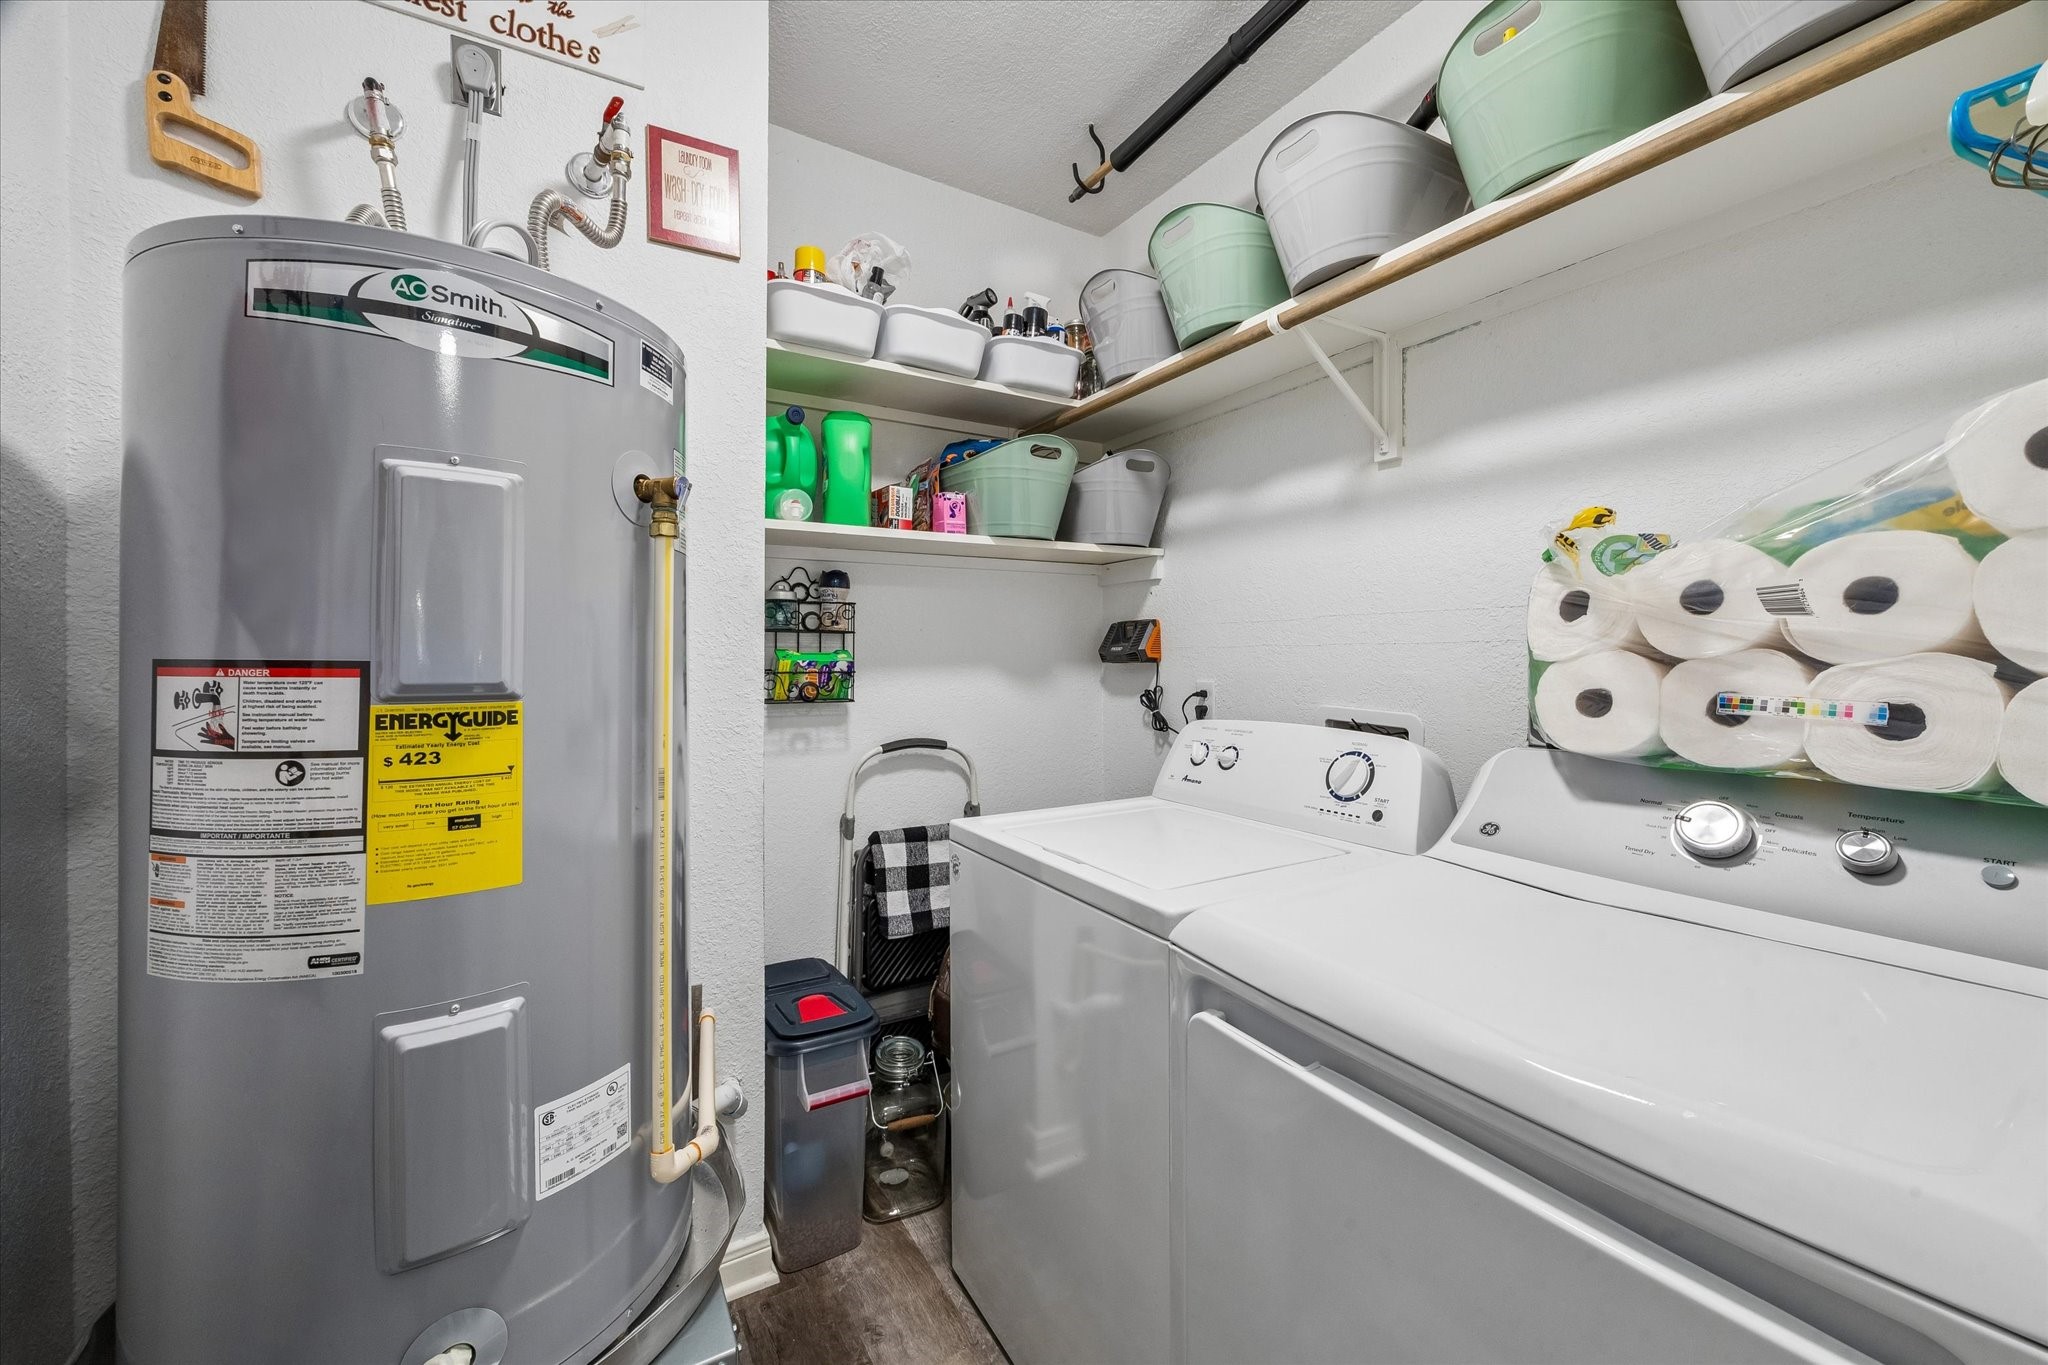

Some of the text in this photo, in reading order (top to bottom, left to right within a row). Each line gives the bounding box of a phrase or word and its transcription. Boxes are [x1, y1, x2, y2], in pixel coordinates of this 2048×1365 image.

[547, 0, 575, 19] the
[489, 9, 601, 65] clothes
[384, 751, 441, 767] $ 423
[1182, 774, 1202, 785] Amana
[1775, 811, 1804, 820] Casuals
[1847, 811, 1905, 825] Temperature
[1625, 846, 1656, 856] Timed Dry
[1781, 846, 1817, 857] Delicates
[1983, 857, 2017, 866] START
